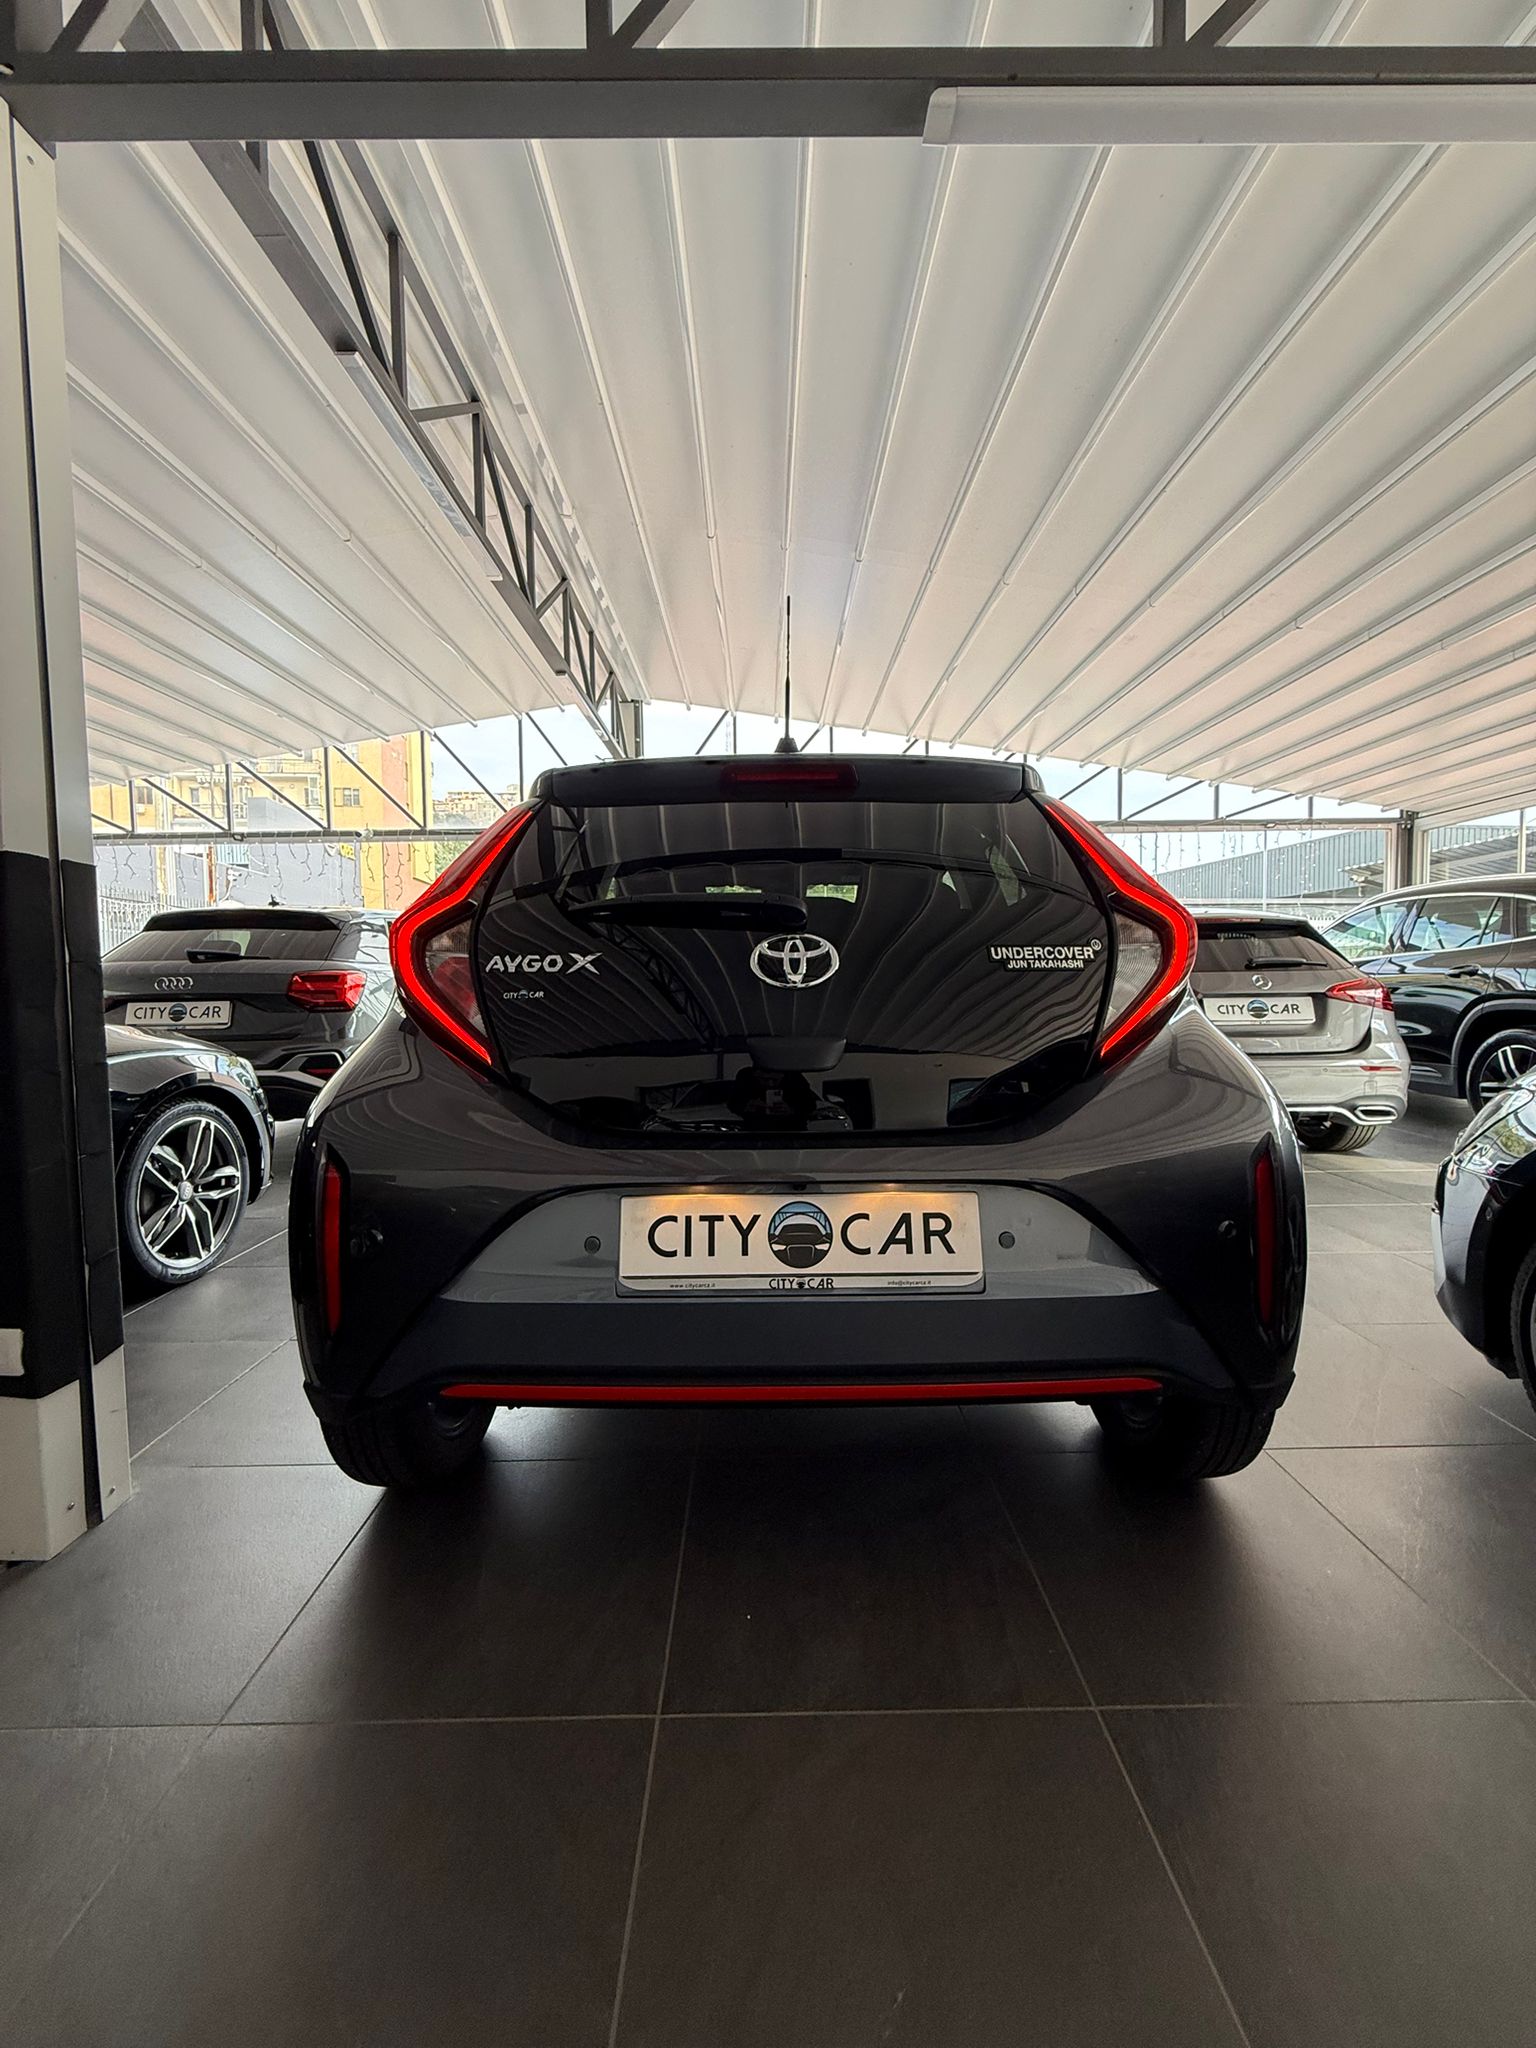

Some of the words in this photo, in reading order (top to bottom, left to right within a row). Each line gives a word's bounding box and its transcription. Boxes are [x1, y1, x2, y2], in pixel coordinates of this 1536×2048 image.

[990, 946, 1094, 959] UNDERCOVER
[485, 955, 564, 973] AYGO
[565, 952, 603, 975] X
[1007, 960, 1028, 969] JUN
[1029, 960, 1084, 969] TAKAHASHI
[528, 991, 545, 999] CAR
[133, 1006, 167, 1019] CITY
[188, 1006, 222, 1018] CAR
[1217, 1004, 1246, 1015] CITY
[1270, 1003, 1301, 1014] CAR
[647, 1214, 762, 1258] CITY
[840, 1212, 956, 1255] CAR
[768, 1278, 796, 1289] CITY
[807, 1277, 834, 1289] CAR
